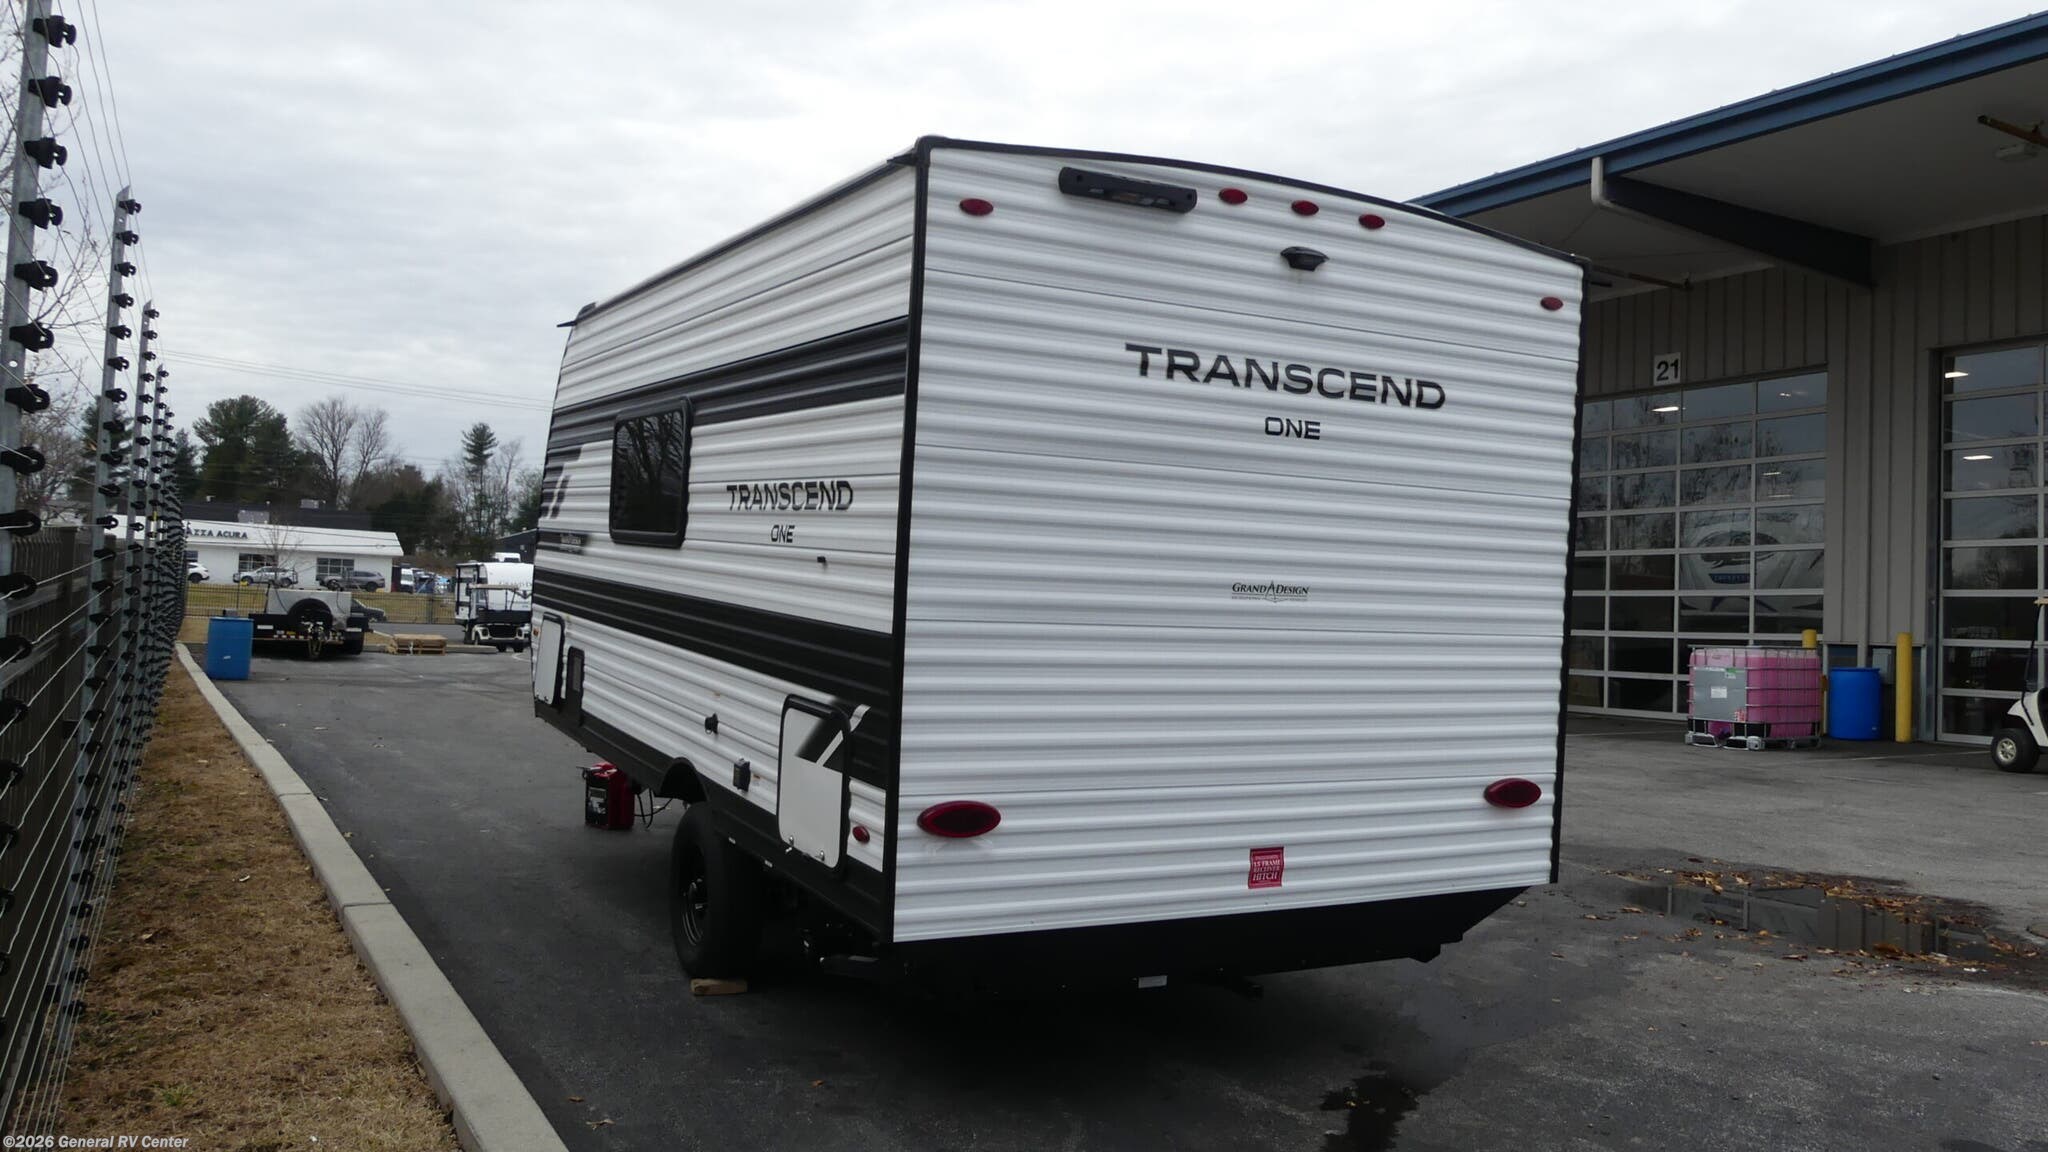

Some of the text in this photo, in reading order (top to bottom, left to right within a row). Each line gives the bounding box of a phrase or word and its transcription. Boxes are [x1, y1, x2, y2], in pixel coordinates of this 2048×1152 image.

[1125, 343, 1446, 410] TRANSCEND
[1656, 358, 1679, 382] 21
[1264, 416, 1321, 441] ONE
[726, 480, 854, 512] TRANSCEND
[216, 526, 248, 539] ACURA
[770, 524, 795, 543] ONE
[1232, 582, 1310, 595] GRAND DESIGN
